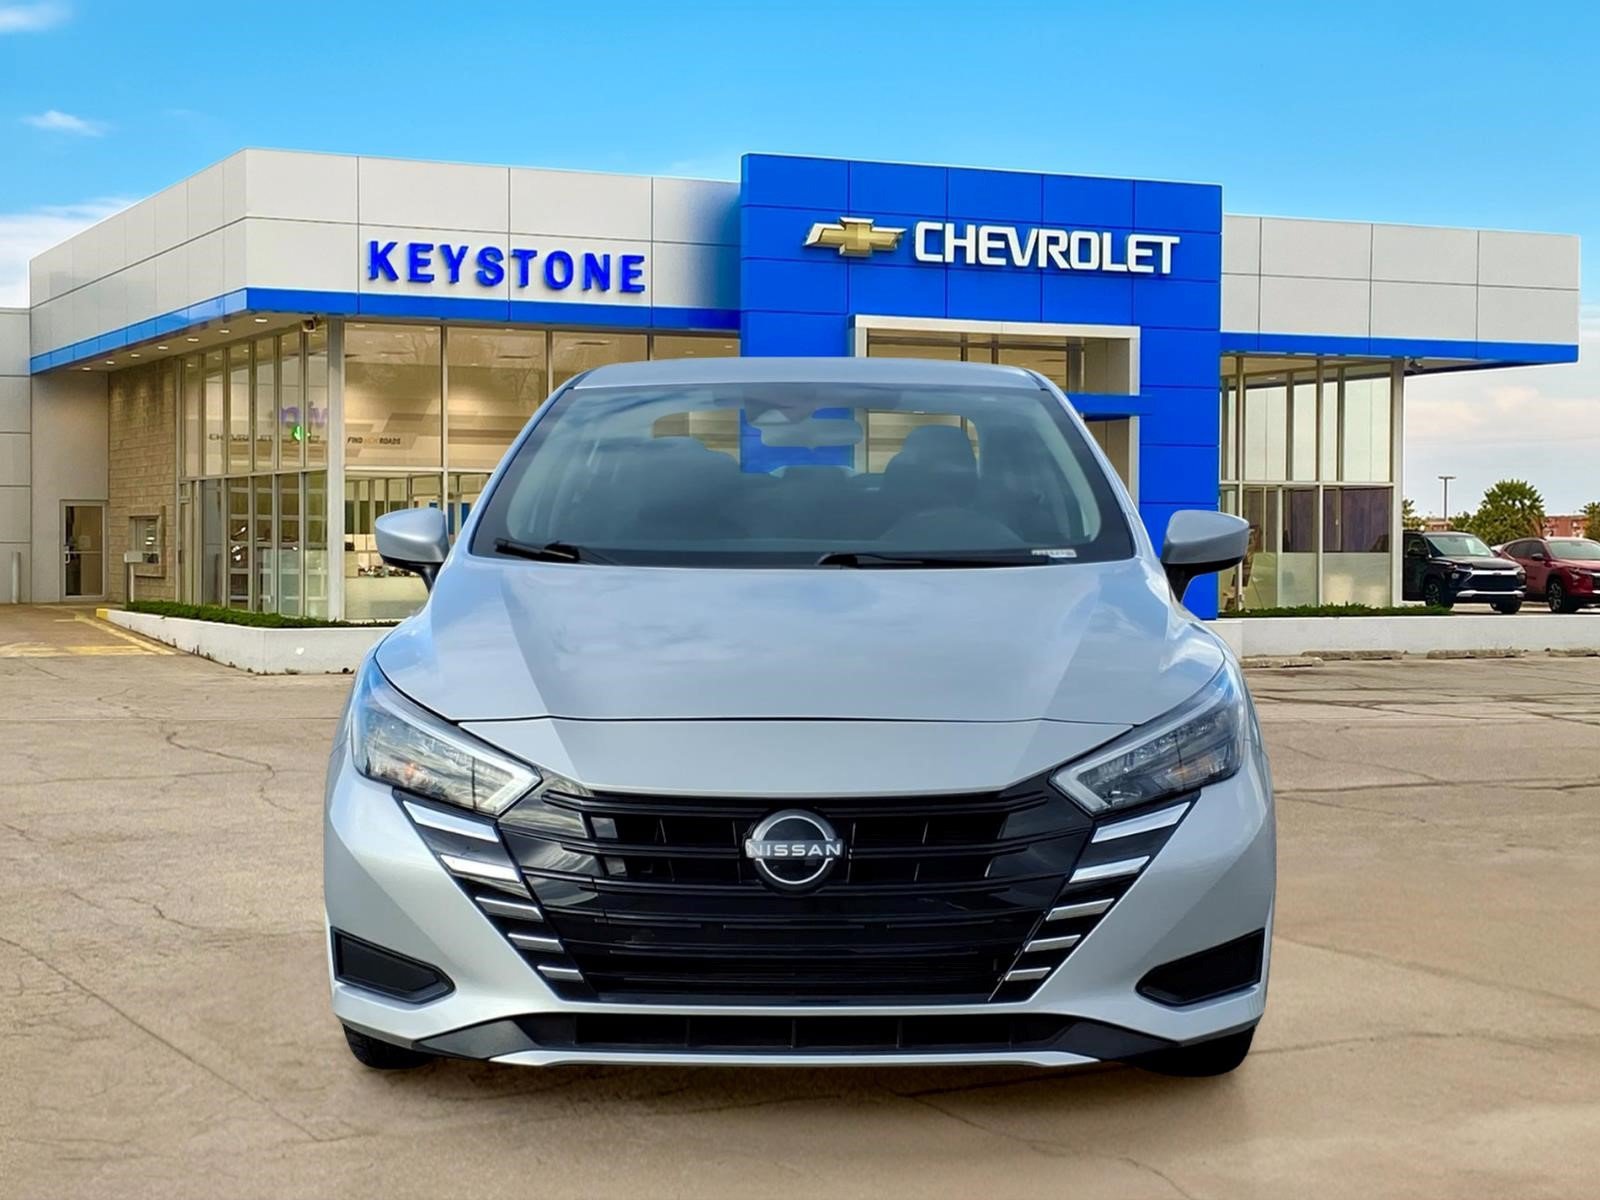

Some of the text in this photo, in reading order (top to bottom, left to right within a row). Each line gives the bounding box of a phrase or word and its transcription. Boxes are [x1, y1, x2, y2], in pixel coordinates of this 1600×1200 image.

[367, 240, 646, 293] KEYSTONE
[914, 220, 1180, 274] CHEVROLET
[748, 843, 841, 857] NISSAN
